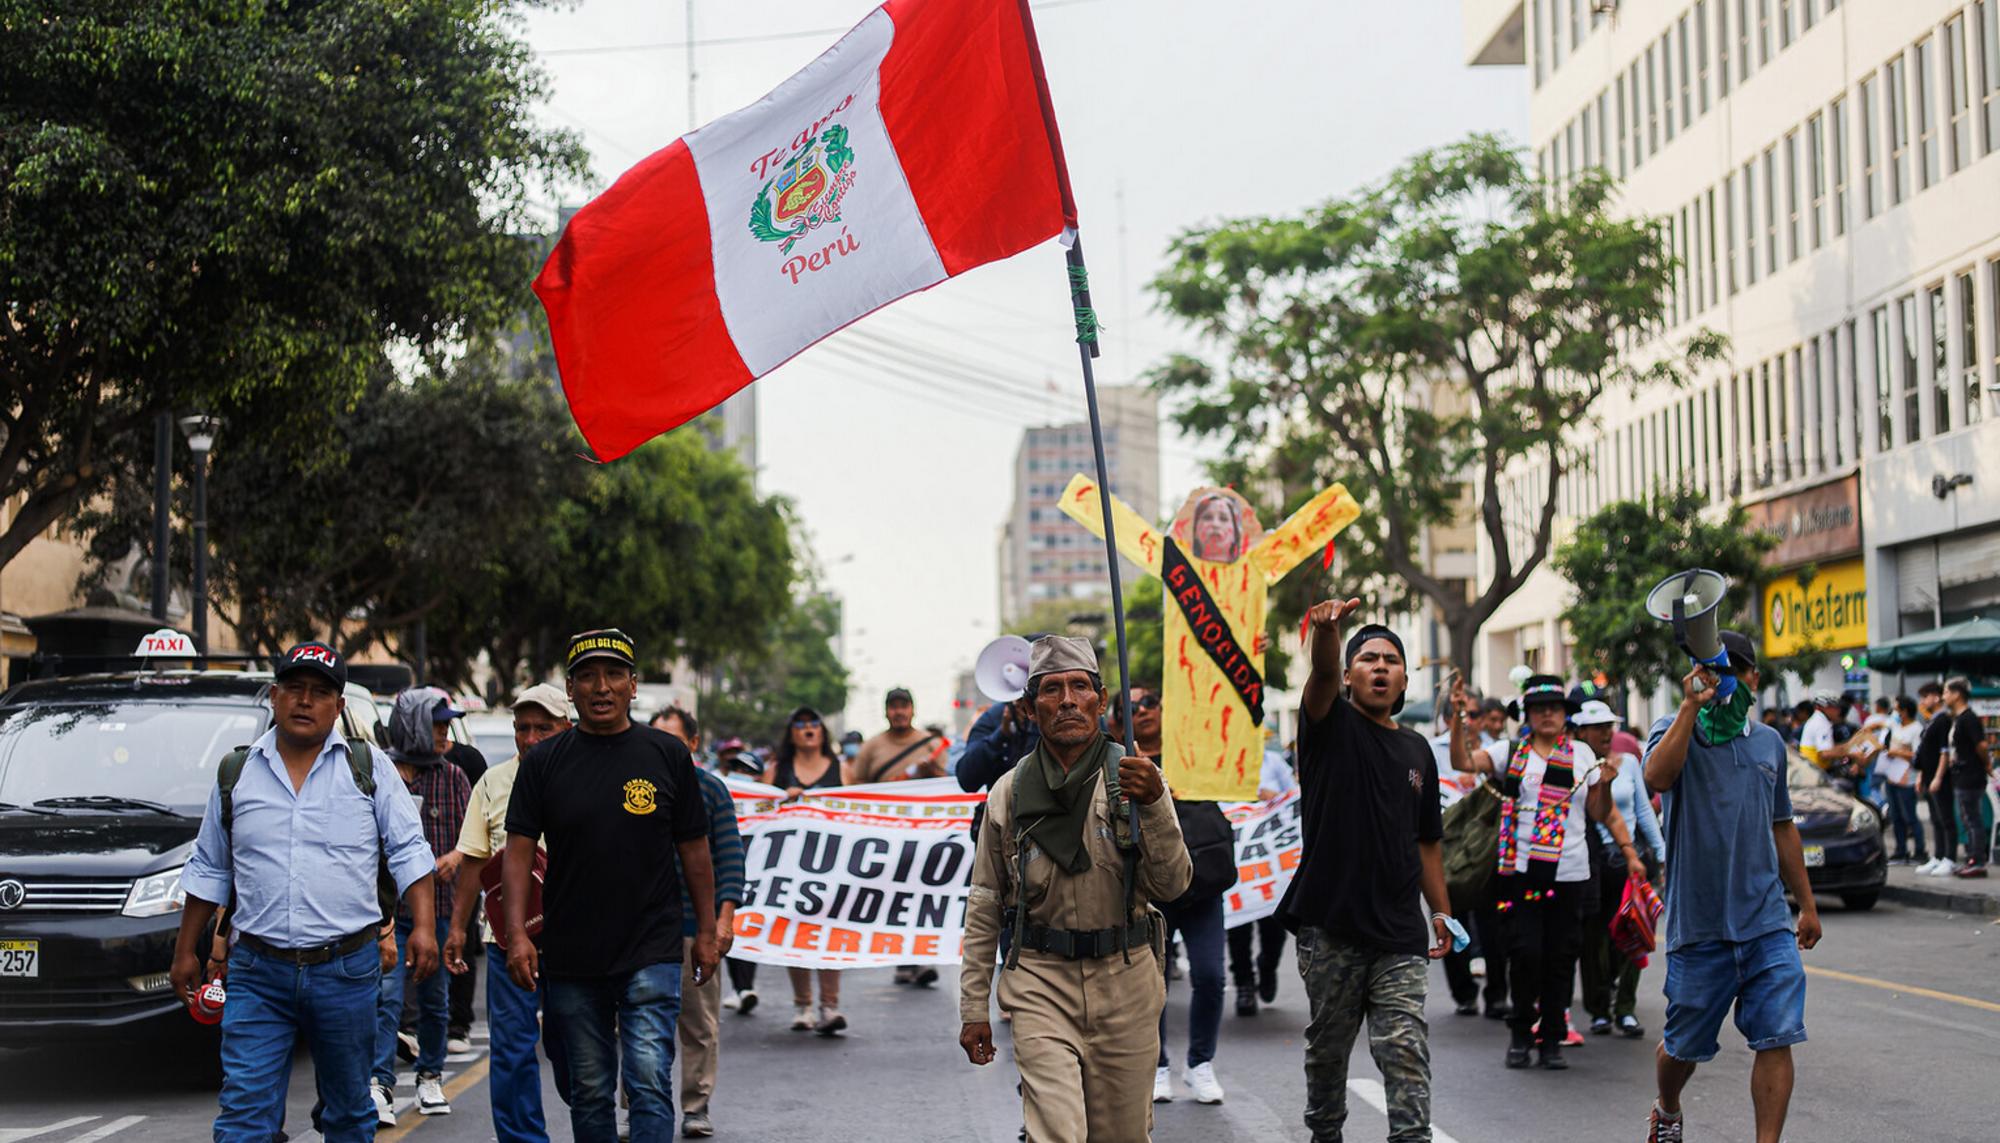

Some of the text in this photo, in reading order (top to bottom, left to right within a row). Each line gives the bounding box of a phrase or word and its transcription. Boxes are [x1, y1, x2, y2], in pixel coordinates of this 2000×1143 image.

[750, 94, 857, 180] Te amo
[780, 225, 861, 285] Perú
[145, 638, 184, 651] TAXI
[291, 645, 336, 668] PERU
[1167, 564, 1262, 706] GENOCIDA
[740, 829, 973, 888] TUCIÓ
[732, 911, 940, 957] CIERRE
